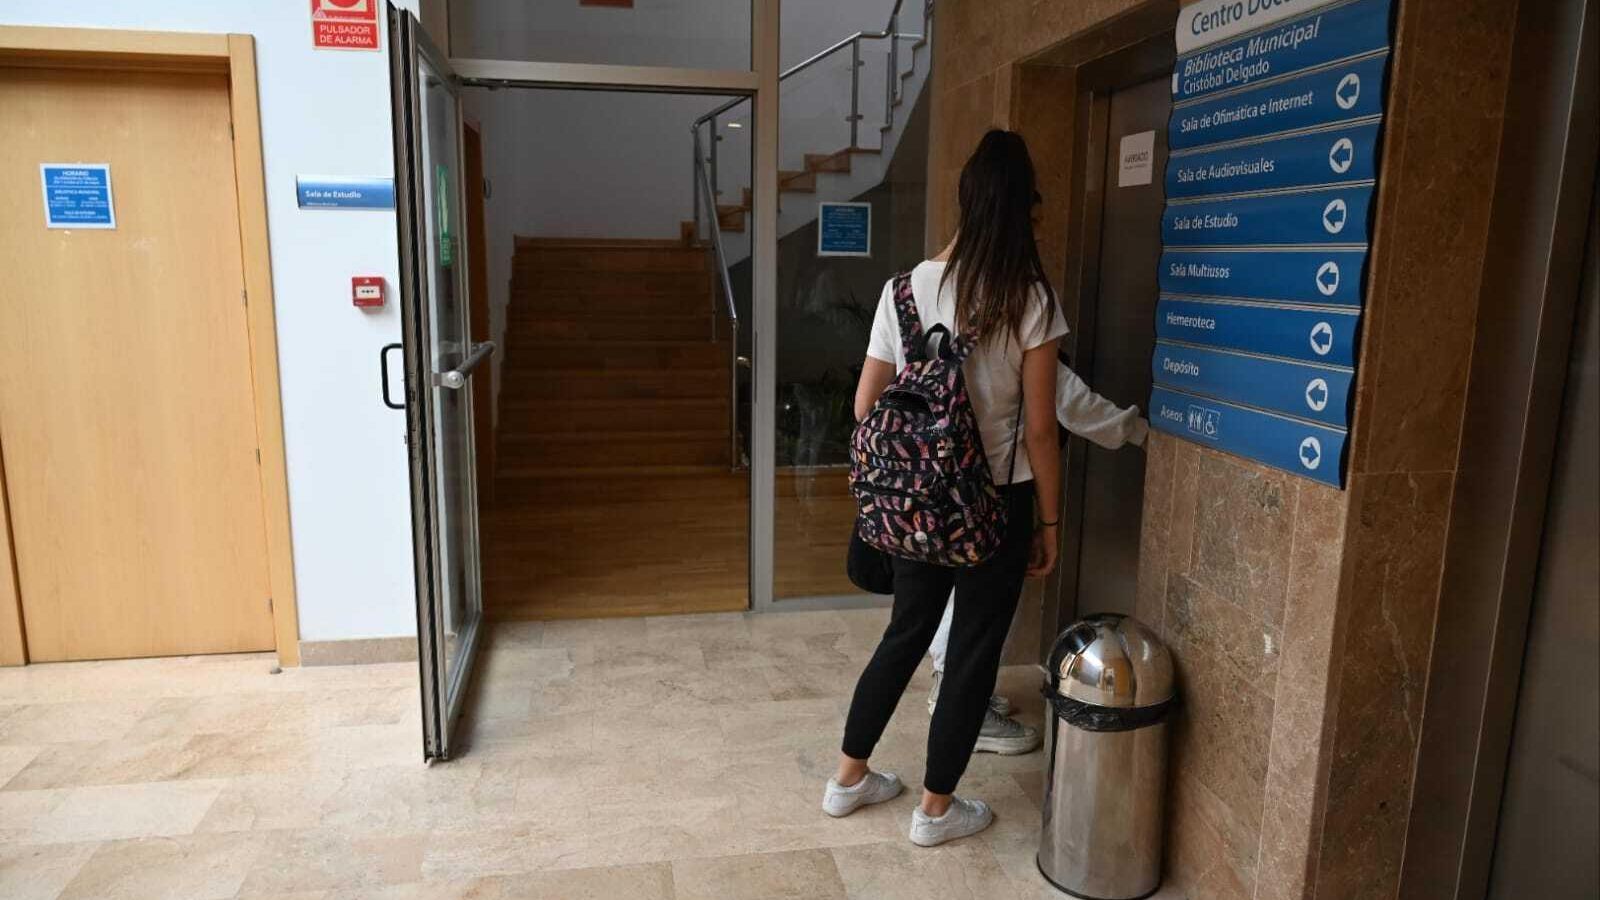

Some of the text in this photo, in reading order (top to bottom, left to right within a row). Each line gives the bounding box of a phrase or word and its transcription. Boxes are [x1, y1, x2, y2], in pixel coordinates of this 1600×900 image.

[1191, 2, 1243, 35] Centro
[319, 24, 370, 35] PULSADOR
[320, 35, 373, 45] DE ALARMA
[1184, 17, 1321, 77] Biblioteca Municipal
[1183, 59, 1270, 95] Cristóbal Delgado
[1181, 91, 1314, 133] Sala de Ofimática e Internet
[1177, 158, 1275, 183] Sala de Audiovisuales
[305, 190, 362, 199] Sala de Estudio
[1173, 213, 1239, 230] Sala de Estudio
[1170, 263, 1231, 279] Sala Multiusos
[1167, 311, 1216, 330] Hemeroteca
[1163, 357, 1200, 376] Depósito
[1160, 405, 1183, 422] Aseos
